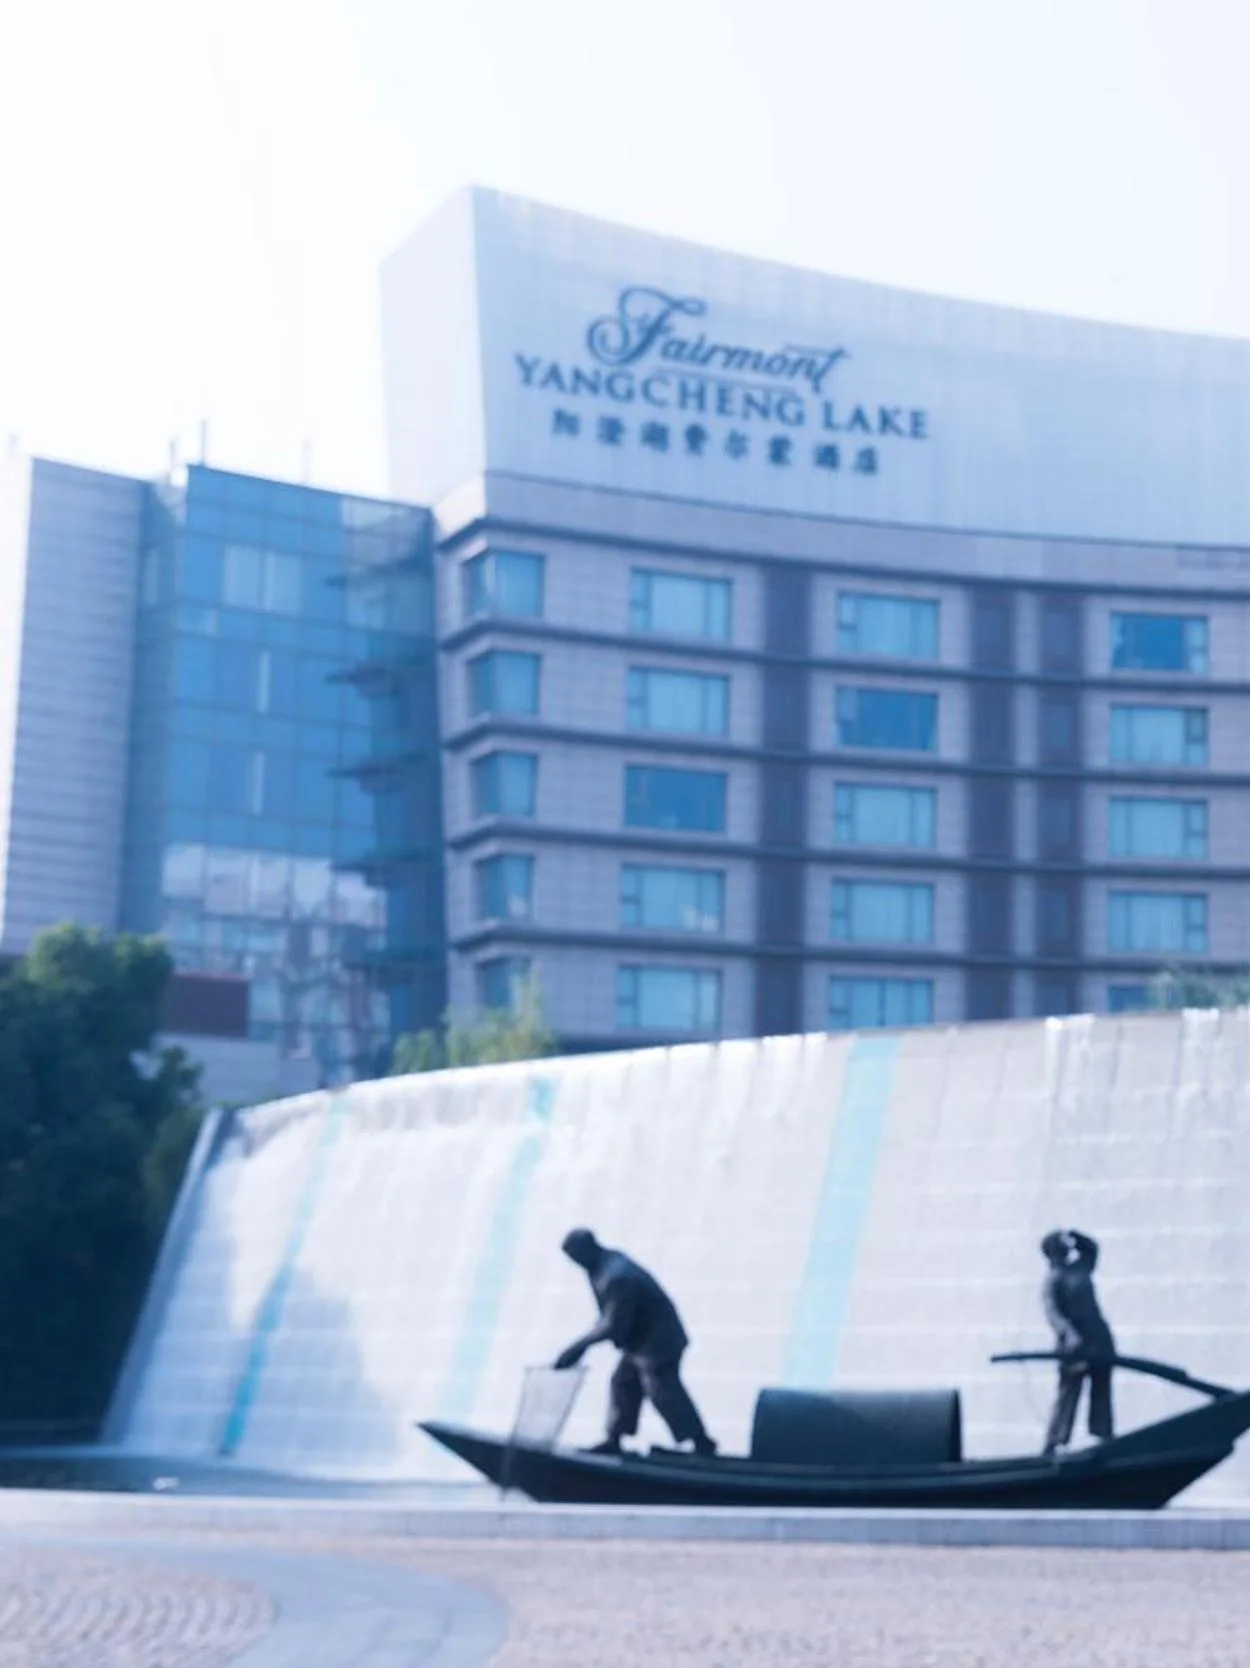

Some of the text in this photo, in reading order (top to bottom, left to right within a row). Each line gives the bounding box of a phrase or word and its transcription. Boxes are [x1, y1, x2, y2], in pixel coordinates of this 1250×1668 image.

[586, 285, 850, 394] Fairmont
[514, 352, 929, 439] YANGCHENG LAKE
